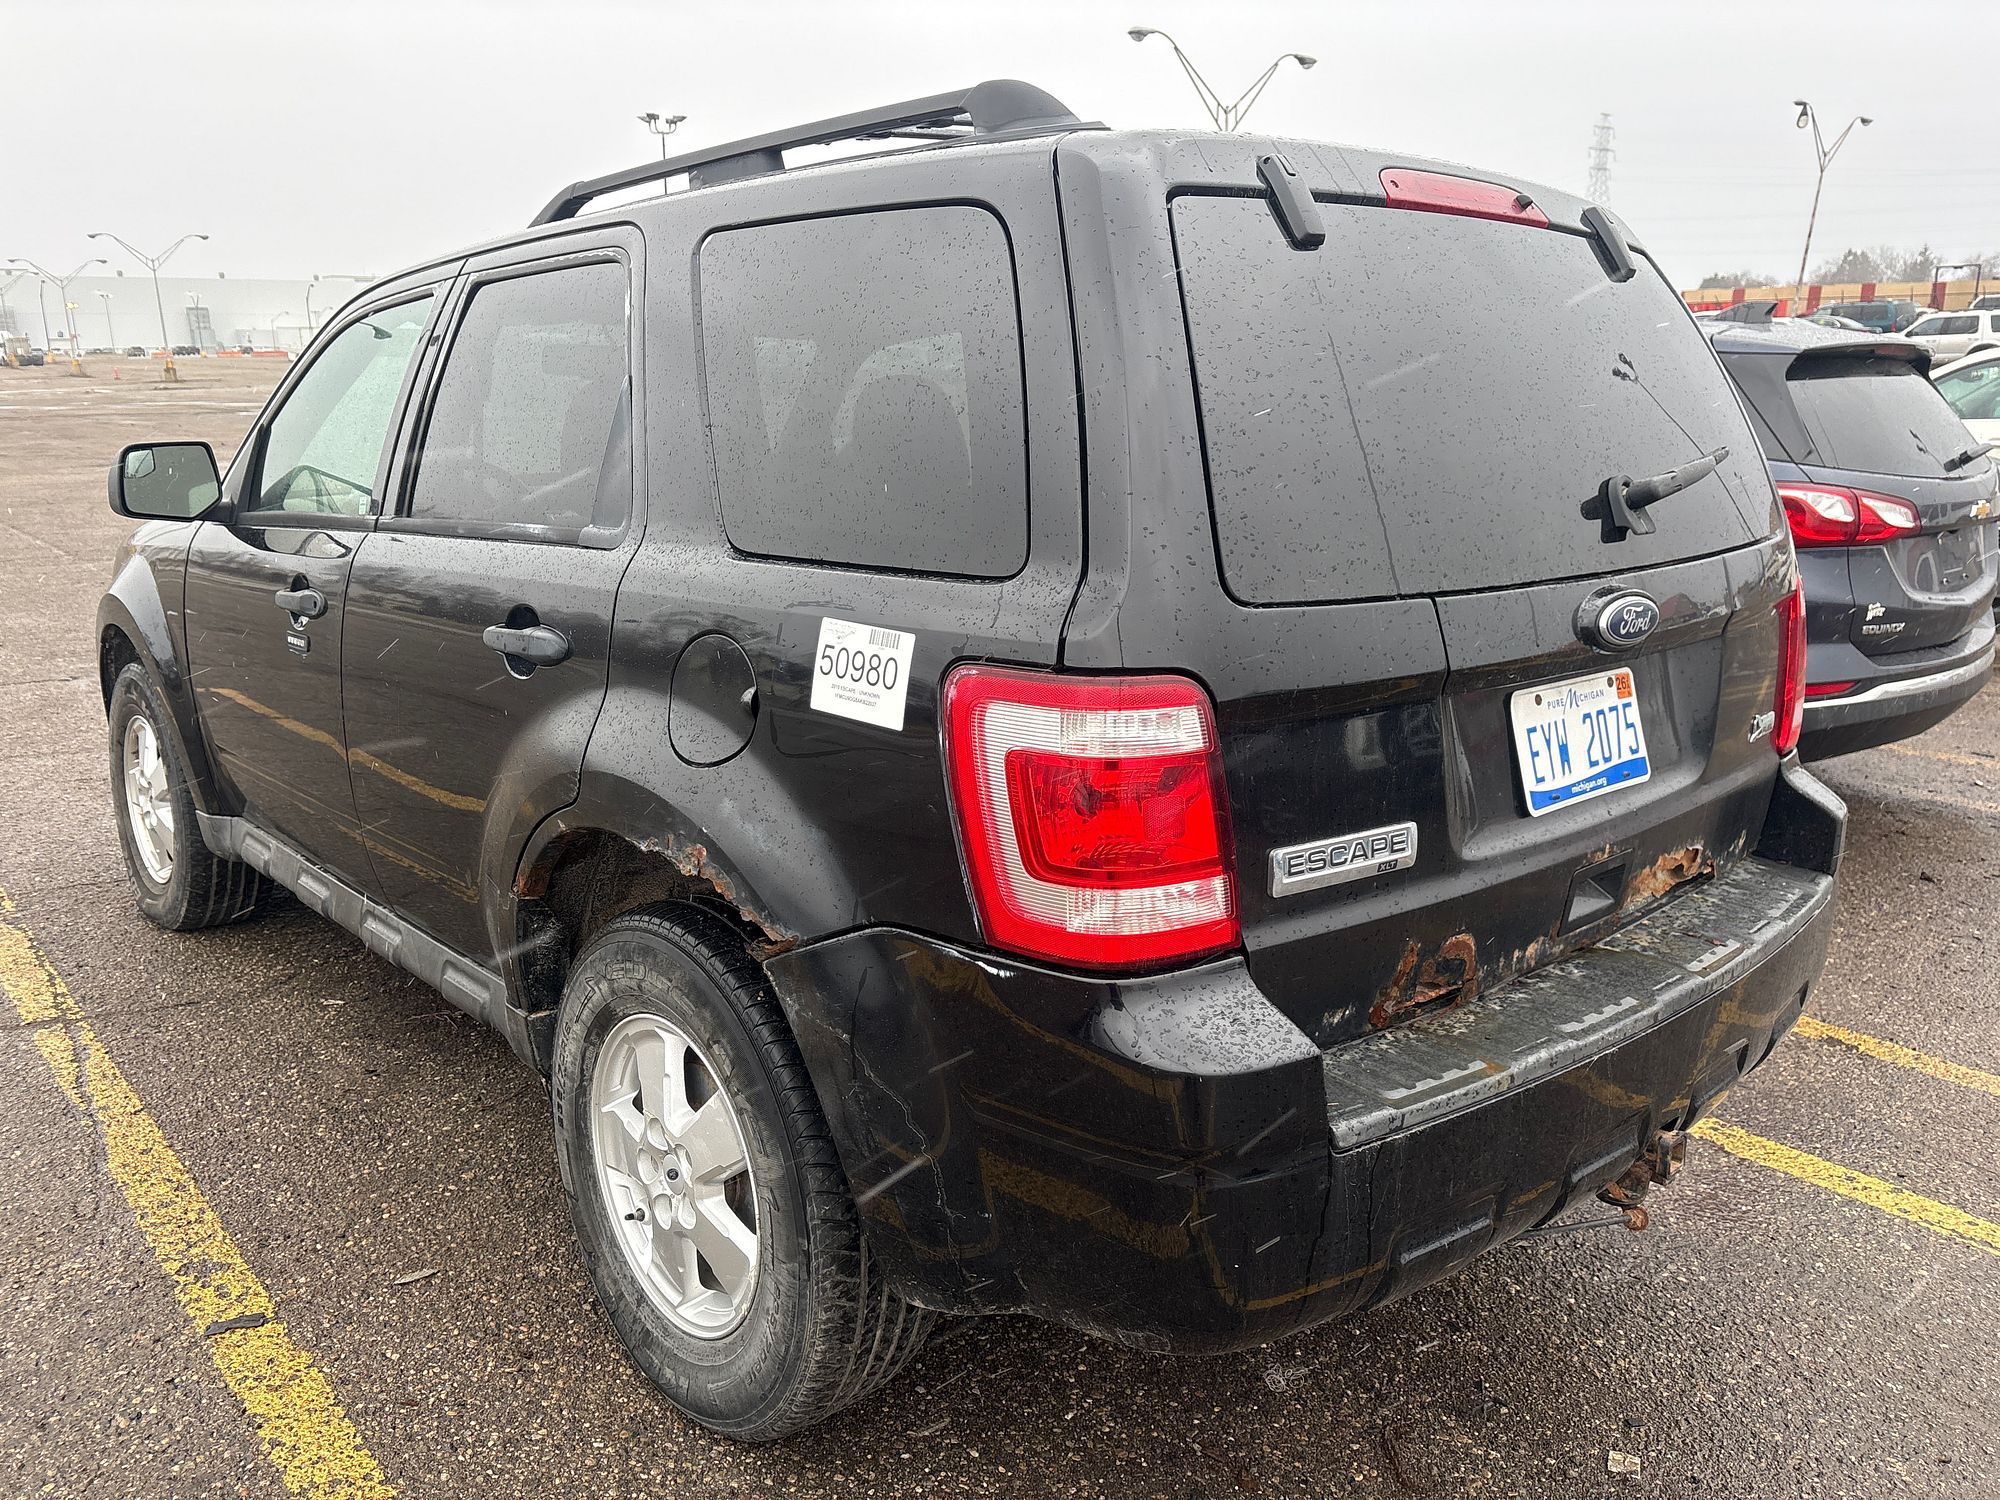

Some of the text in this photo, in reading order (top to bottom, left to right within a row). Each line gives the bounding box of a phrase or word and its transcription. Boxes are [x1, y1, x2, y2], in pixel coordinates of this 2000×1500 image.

[1620, 605, 1652, 635] Ford
[820, 644, 898, 690] 50980
[1615, 677, 1626, 691] 26
[1547, 688, 1605, 715] PURE MICHIGAN
[1526, 702, 1640, 785] EYW 2075
[1571, 776, 1608, 795] michigan.org
[1287, 831, 1408, 877] ESCAPE
[1378, 861, 1398, 872] XLT
